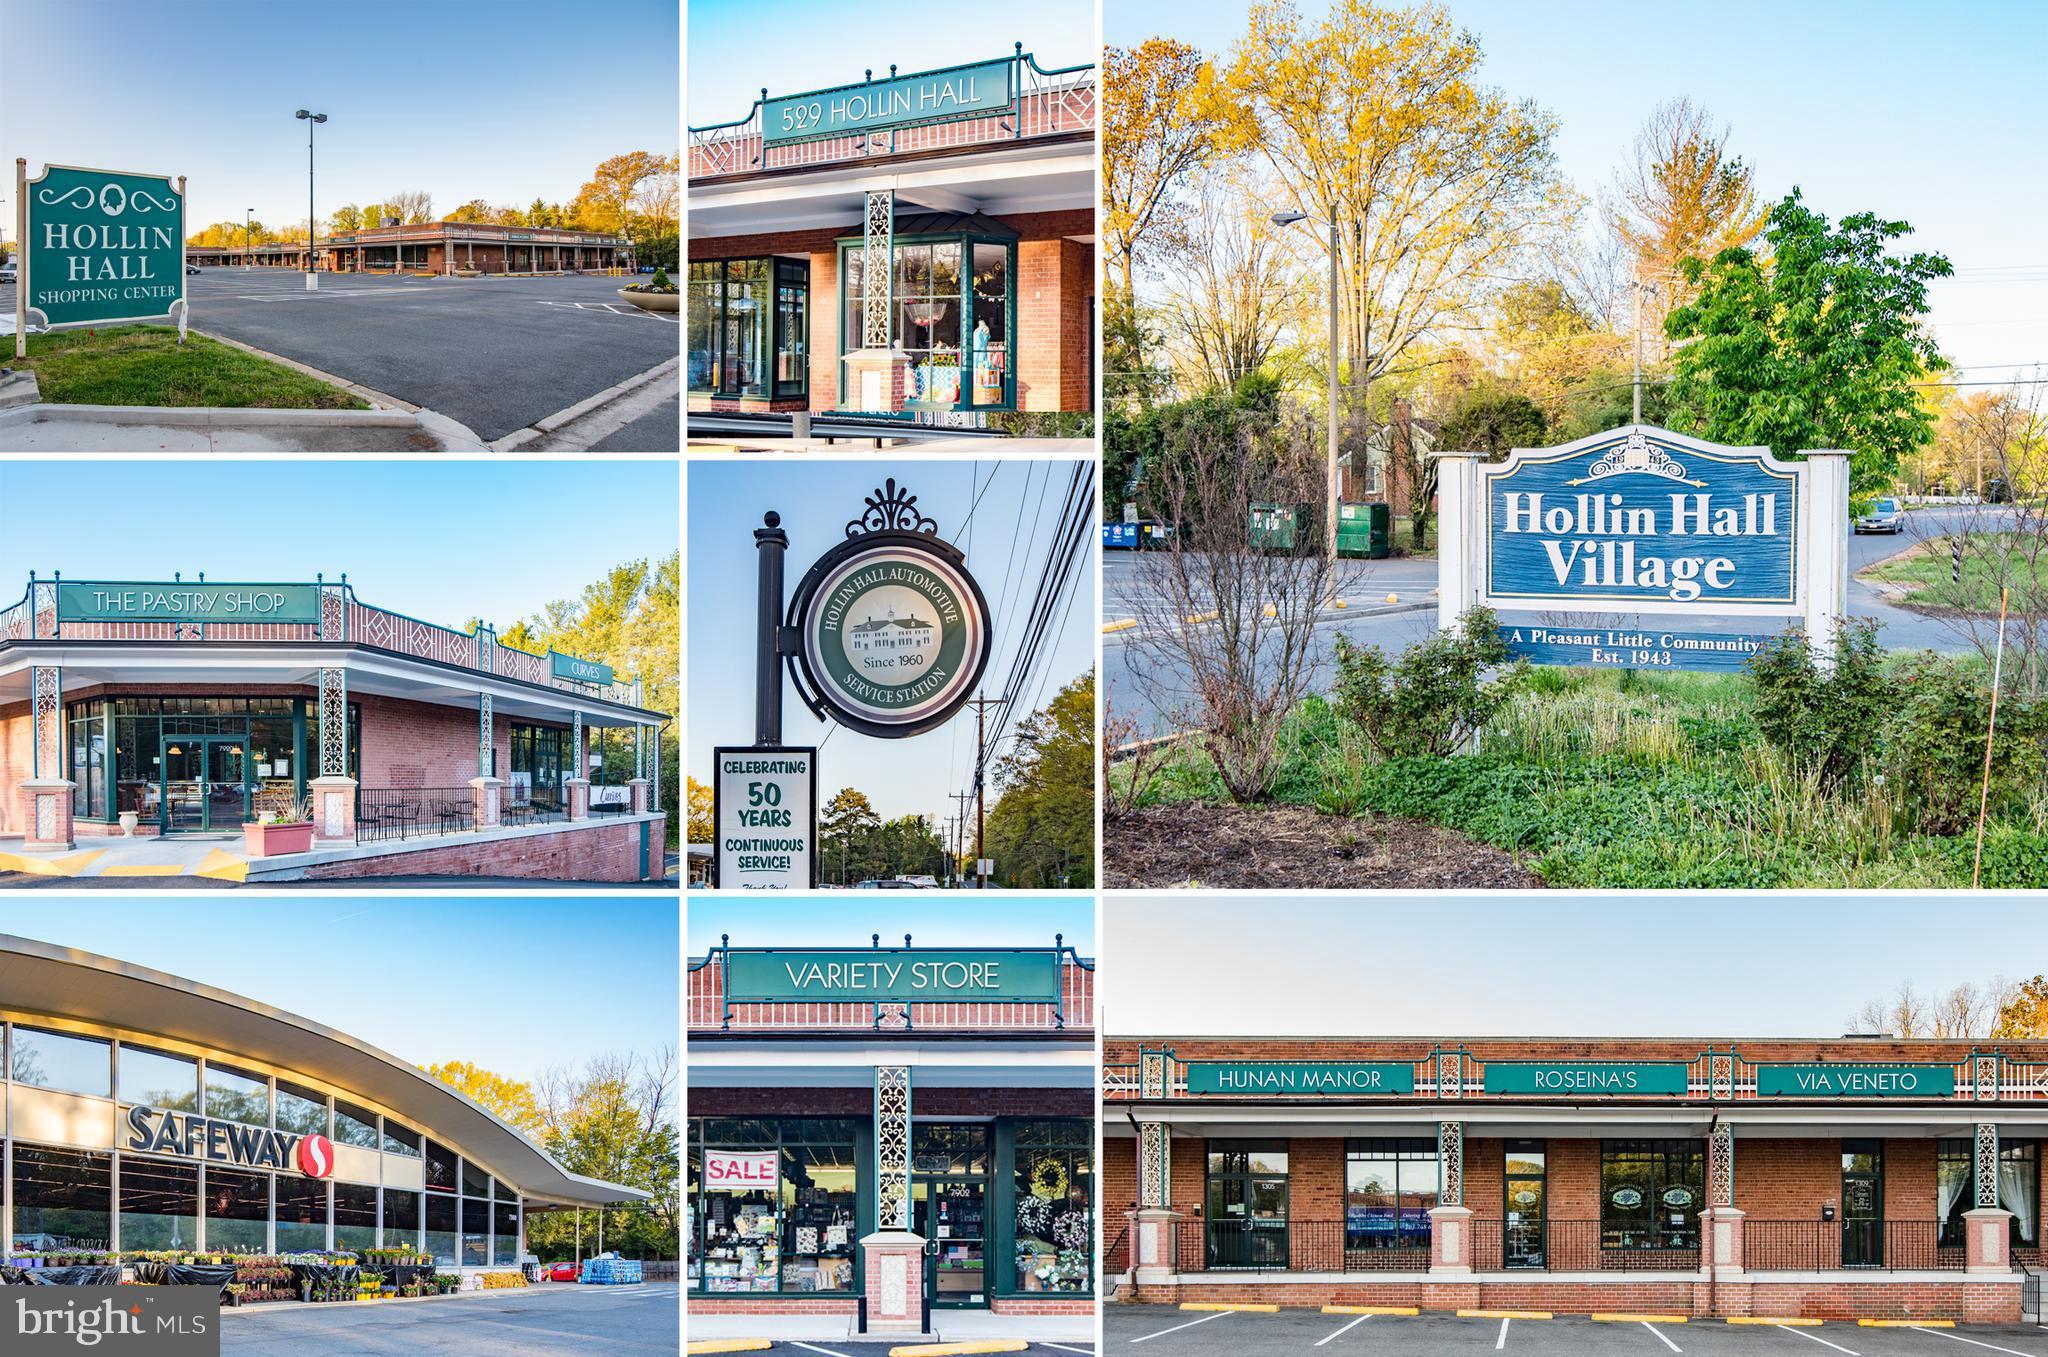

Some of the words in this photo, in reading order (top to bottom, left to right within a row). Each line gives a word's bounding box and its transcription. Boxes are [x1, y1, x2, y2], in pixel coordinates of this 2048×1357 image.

[781, 103, 823, 132] 529
[831, 87, 913, 125] HOLLIN
[920, 77, 982, 111] HALL
[43, 223, 173, 250] HOLLIN
[67, 255, 156, 281] HALL
[38, 288, 118, 304] SHOPPING
[123, 285, 176, 299] CENTER
[1503, 492, 1658, 536] Hollin
[1668, 493, 1778, 536] Hall
[1540, 540, 1737, 601] Village
[93, 592, 136, 612] THE
[143, 592, 219, 612] PASTRY
[224, 592, 285, 613] SHOP
[824, 585, 858, 632] HOLLIN
[853, 569, 888, 591] HALL
[889, 568, 959, 624] AUTOMOTIVE
[1511, 629, 1523, 643] A
[1531, 630, 1600, 646] Pleasant
[1607, 632, 1653, 648] Little
[1660, 635, 1761, 655] Community
[864, 657, 895, 669] Since
[899, 654, 924, 666] 1960
[1592, 649, 1624, 664] Est.
[1631, 650, 1672, 666] 1943
[571, 662, 600, 680] CURVES
[843, 673, 894, 703] SERVICE
[896, 666, 947, 702] STATION
[724, 761, 806, 774] CELEBRATING
[600, 787, 622, 803] Curves
[748, 782, 781, 807] 50
[738, 809, 792, 828] YEARS
[725, 839, 804, 852] CONTINUOUS
[738, 856, 791, 869] SERVICE!
[785, 962, 903, 990] VARIETY
[911, 962, 1000, 990] STORE
[1219, 1071, 1295, 1088] HUNAN
[1302, 1071, 1381, 1088] MANOR
[1535, 1070, 1637, 1088] ROSEINA'S
[1797, 1073, 1832, 1090] VIA
[1837, 1073, 1917, 1090] VENETO
[126, 1106, 298, 1169] SAFEWAY
[708, 1159, 775, 1180] SALE
[950, 1188, 970, 1197] 7902
